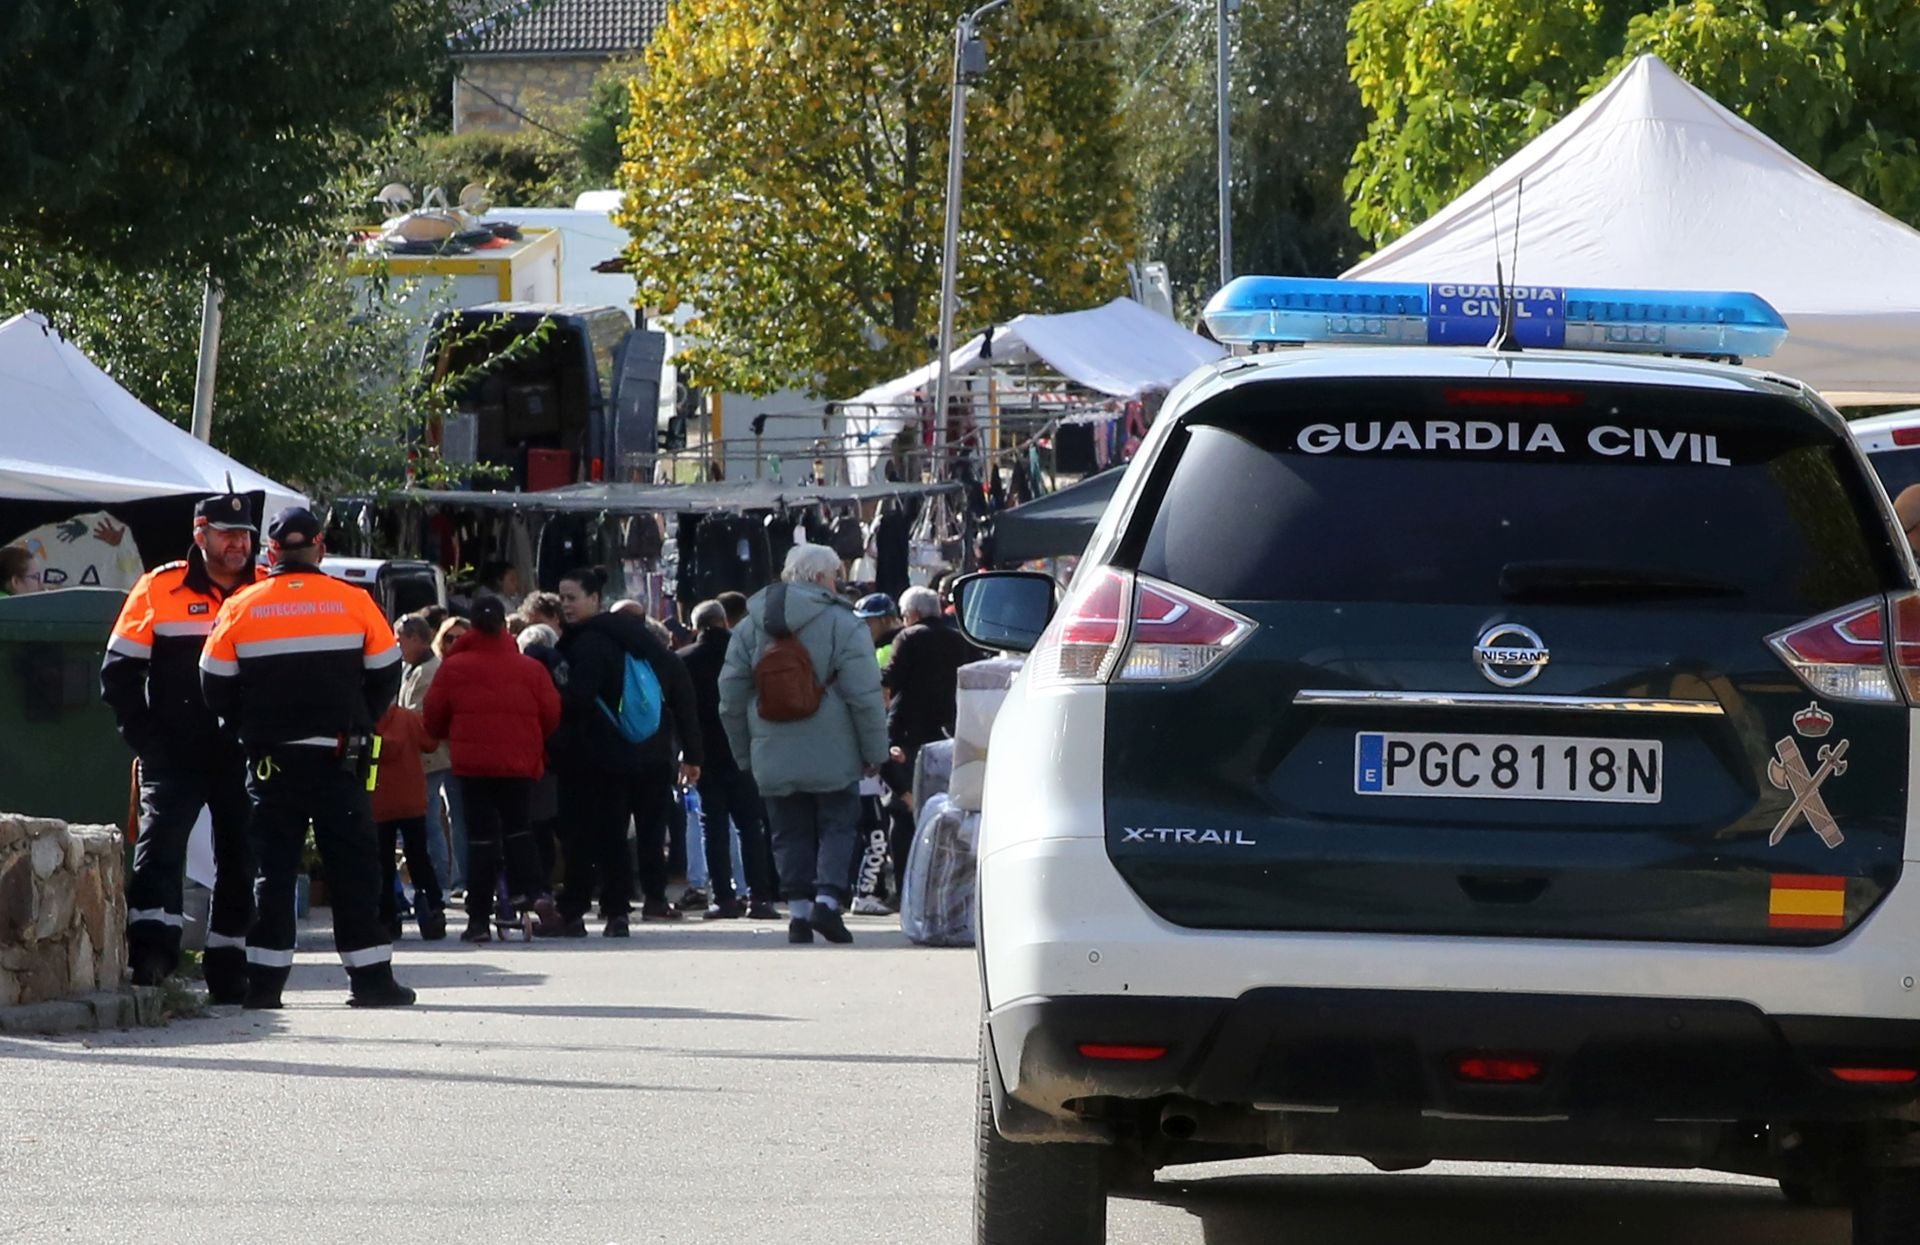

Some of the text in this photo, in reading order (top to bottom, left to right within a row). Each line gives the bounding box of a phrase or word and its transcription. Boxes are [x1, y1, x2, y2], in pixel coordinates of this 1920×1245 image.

[1438, 285, 1556, 300] GUARDIA
[1462, 299, 1532, 318] CIVL
[1297, 420, 1732, 467] GUARDIA CIVIL
[319, 600, 347, 615] CIVIL
[1481, 650, 1542, 662] NISSAN
[1365, 768, 1377, 783] E
[1121, 826, 1256, 845] X-TRAIL
